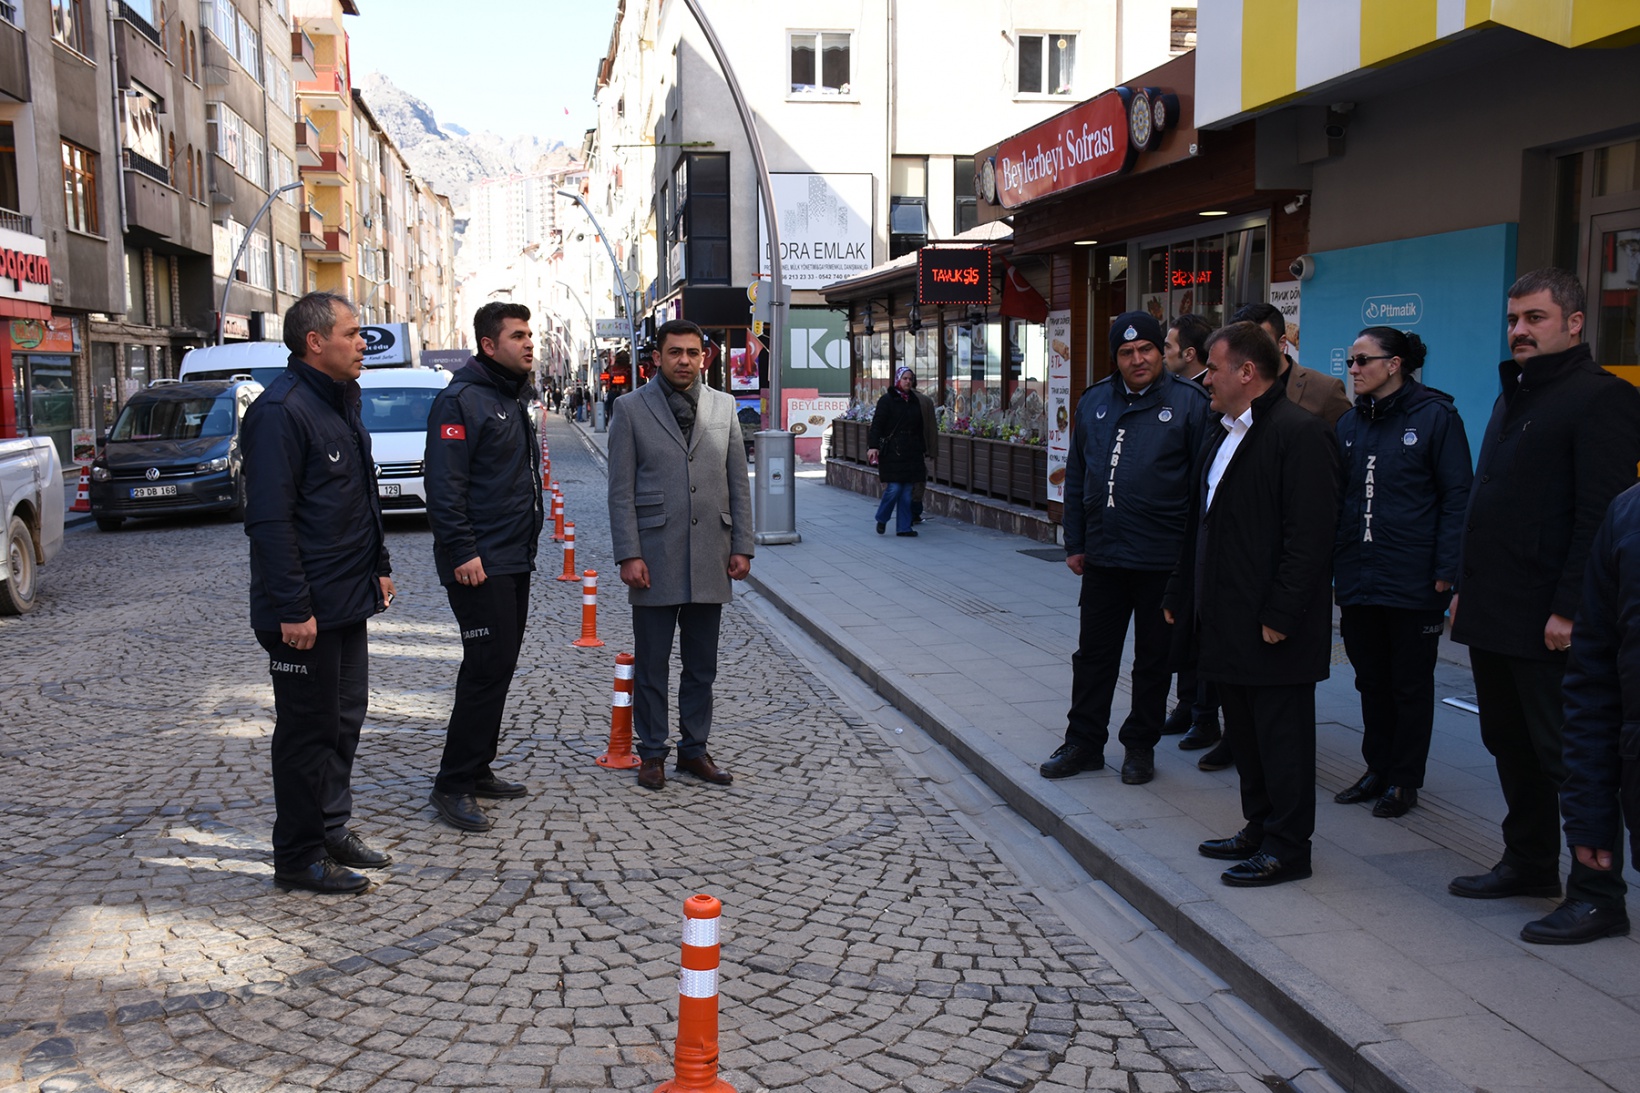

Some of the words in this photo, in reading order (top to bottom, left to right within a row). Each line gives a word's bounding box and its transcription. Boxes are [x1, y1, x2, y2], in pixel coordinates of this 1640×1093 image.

[1002, 134, 1065, 194] Beylerbeyi
[1066, 123, 1115, 167] Sofrası
[814, 242, 866, 260] EMLAK
[1271, 291, 1289, 302] TAVUK
[1281, 302, 1298, 316] DÜRÜM
[1380, 302, 1416, 317] Pttmatik
[1106, 428, 1126, 508] ZABITA
[135, 488, 145, 497] 29
[147, 487, 158, 496] DB
[161, 486, 176, 495] 168
[385, 485, 398, 495] 129
[1363, 455, 1377, 542] ZABITA
[271, 660, 308, 675] ZABITA
